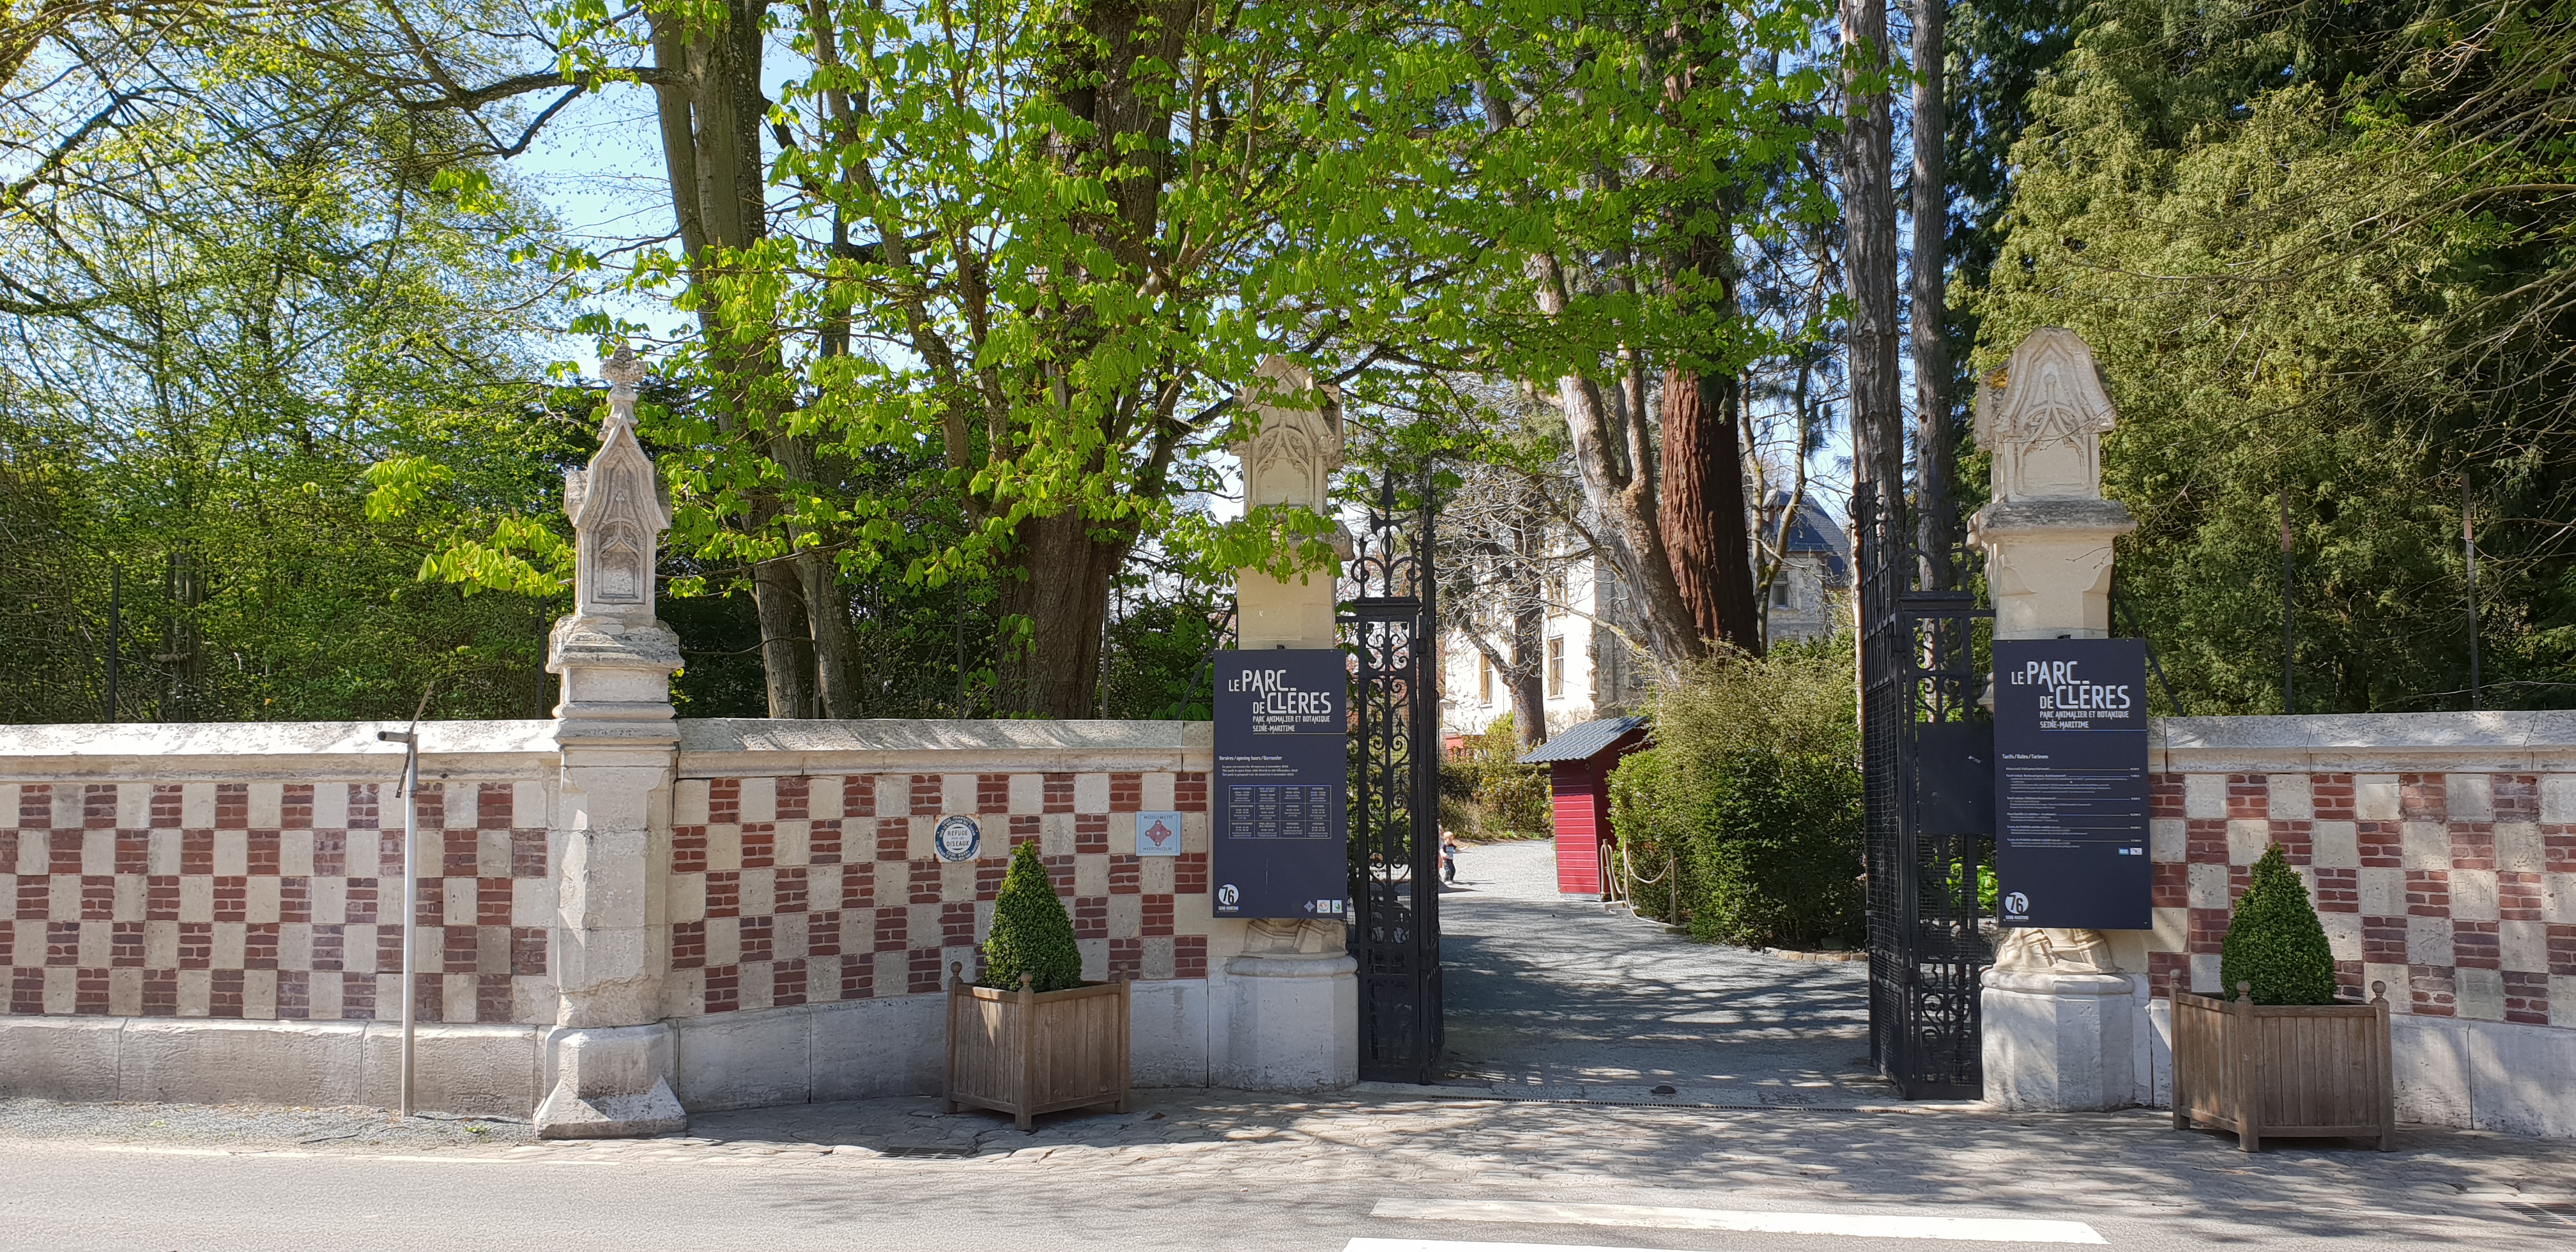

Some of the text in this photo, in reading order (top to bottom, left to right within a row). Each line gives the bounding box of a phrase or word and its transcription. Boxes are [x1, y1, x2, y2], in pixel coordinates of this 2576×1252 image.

[2011, 660, 2081, 693] LE PARC
[1229, 669, 1289, 699] LE PARC
[1252, 701, 1265, 714] DE
[2039, 696, 2054, 709] DE
[1252, 715, 1266, 724] PARC
[1266, 715, 1294, 724] ANIMALIER
[1302, 715, 1331, 724] BOTANIQUE
[2039, 710, 2055, 720] PARC
[2055, 710, 2087, 720] ANIMALIER
[2097, 710, 2129, 720] BOTANIQUE
[1252, 723, 1296, 733] SEINE-MARITIME
[2039, 719, 2089, 729] SEINE-MARITIME
[1220, 886, 1235, 905] 76
[2007, 894, 2024, 914] 76
